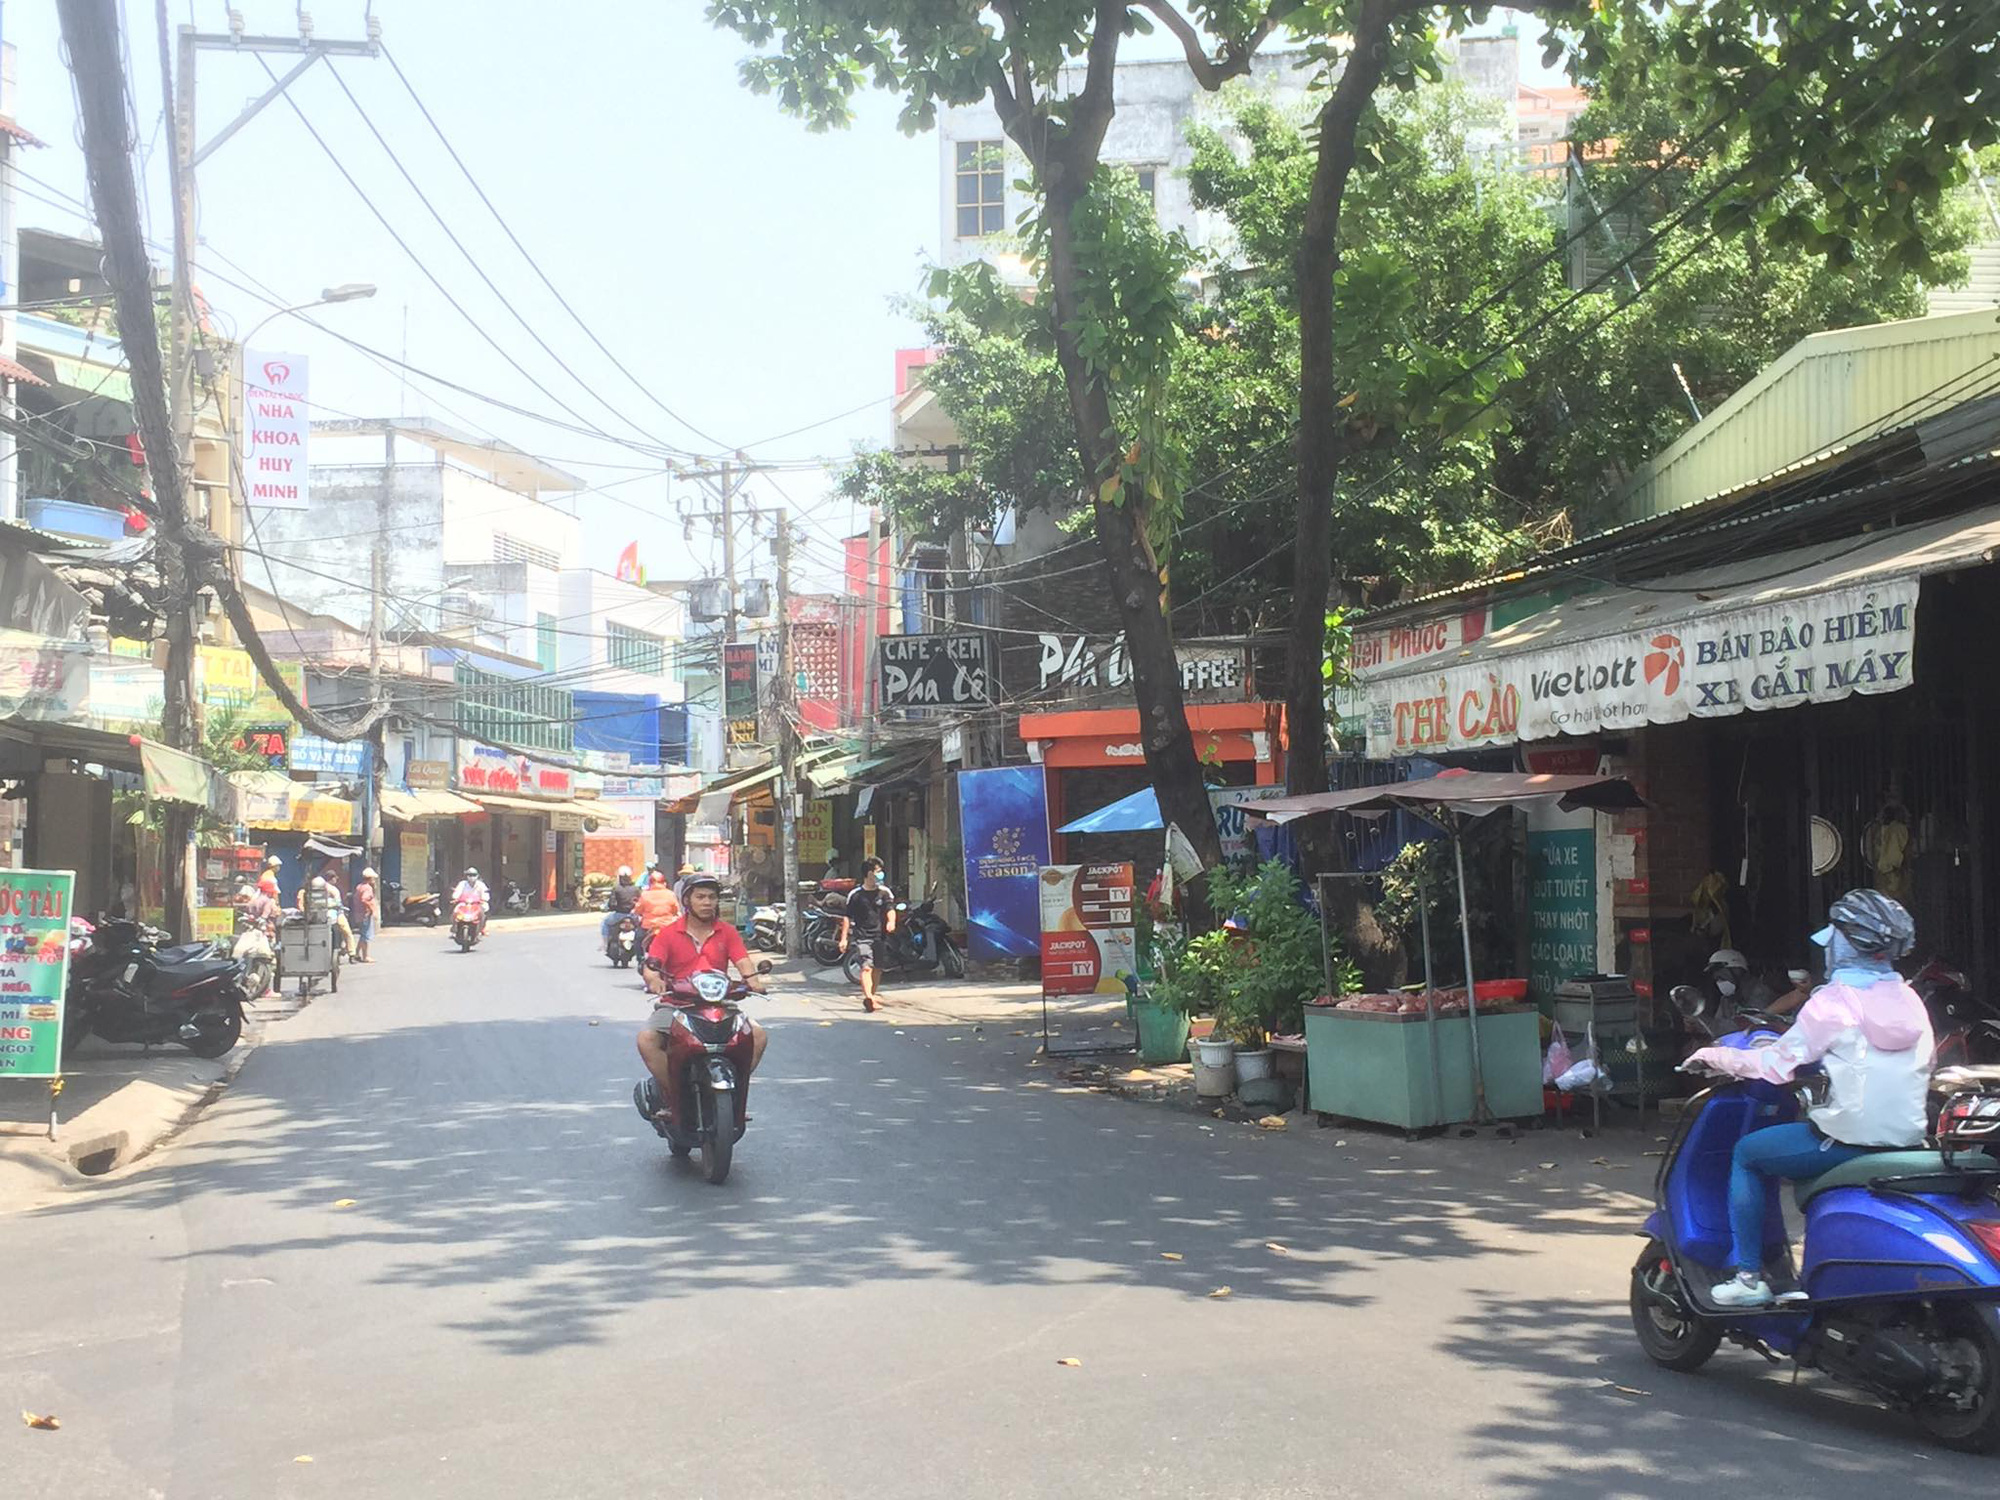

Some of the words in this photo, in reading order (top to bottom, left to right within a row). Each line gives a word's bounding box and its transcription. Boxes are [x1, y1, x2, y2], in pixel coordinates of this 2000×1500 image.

[258, 403, 294, 418] NHA
[251, 430, 301, 446] KHOA
[259, 457, 293, 472] HUY
[253, 484, 298, 499] MINH
[1696, 631, 1752, 666] BÁN
[1759, 615, 1815, 656] BẢO
[1823, 593, 1908, 645] HIỂM
[947, 639, 981, 659] KEM
[884, 665, 940, 704] Pha
[1531, 656, 1637, 702] Vietlott
[1696, 680, 1740, 708] XE
[1751, 656, 1815, 700] GẮN
[1825, 649, 1908, 690] MÁY
[1458, 672, 1519, 739] CÀO
[1564, 846, 1579, 866] XE
[979, 866, 1028, 879] season
[1087, 865, 1124, 876] JACKPOT
[1049, 940, 1087, 951] JACKPOT
[1580, 944, 1594, 963] XE
